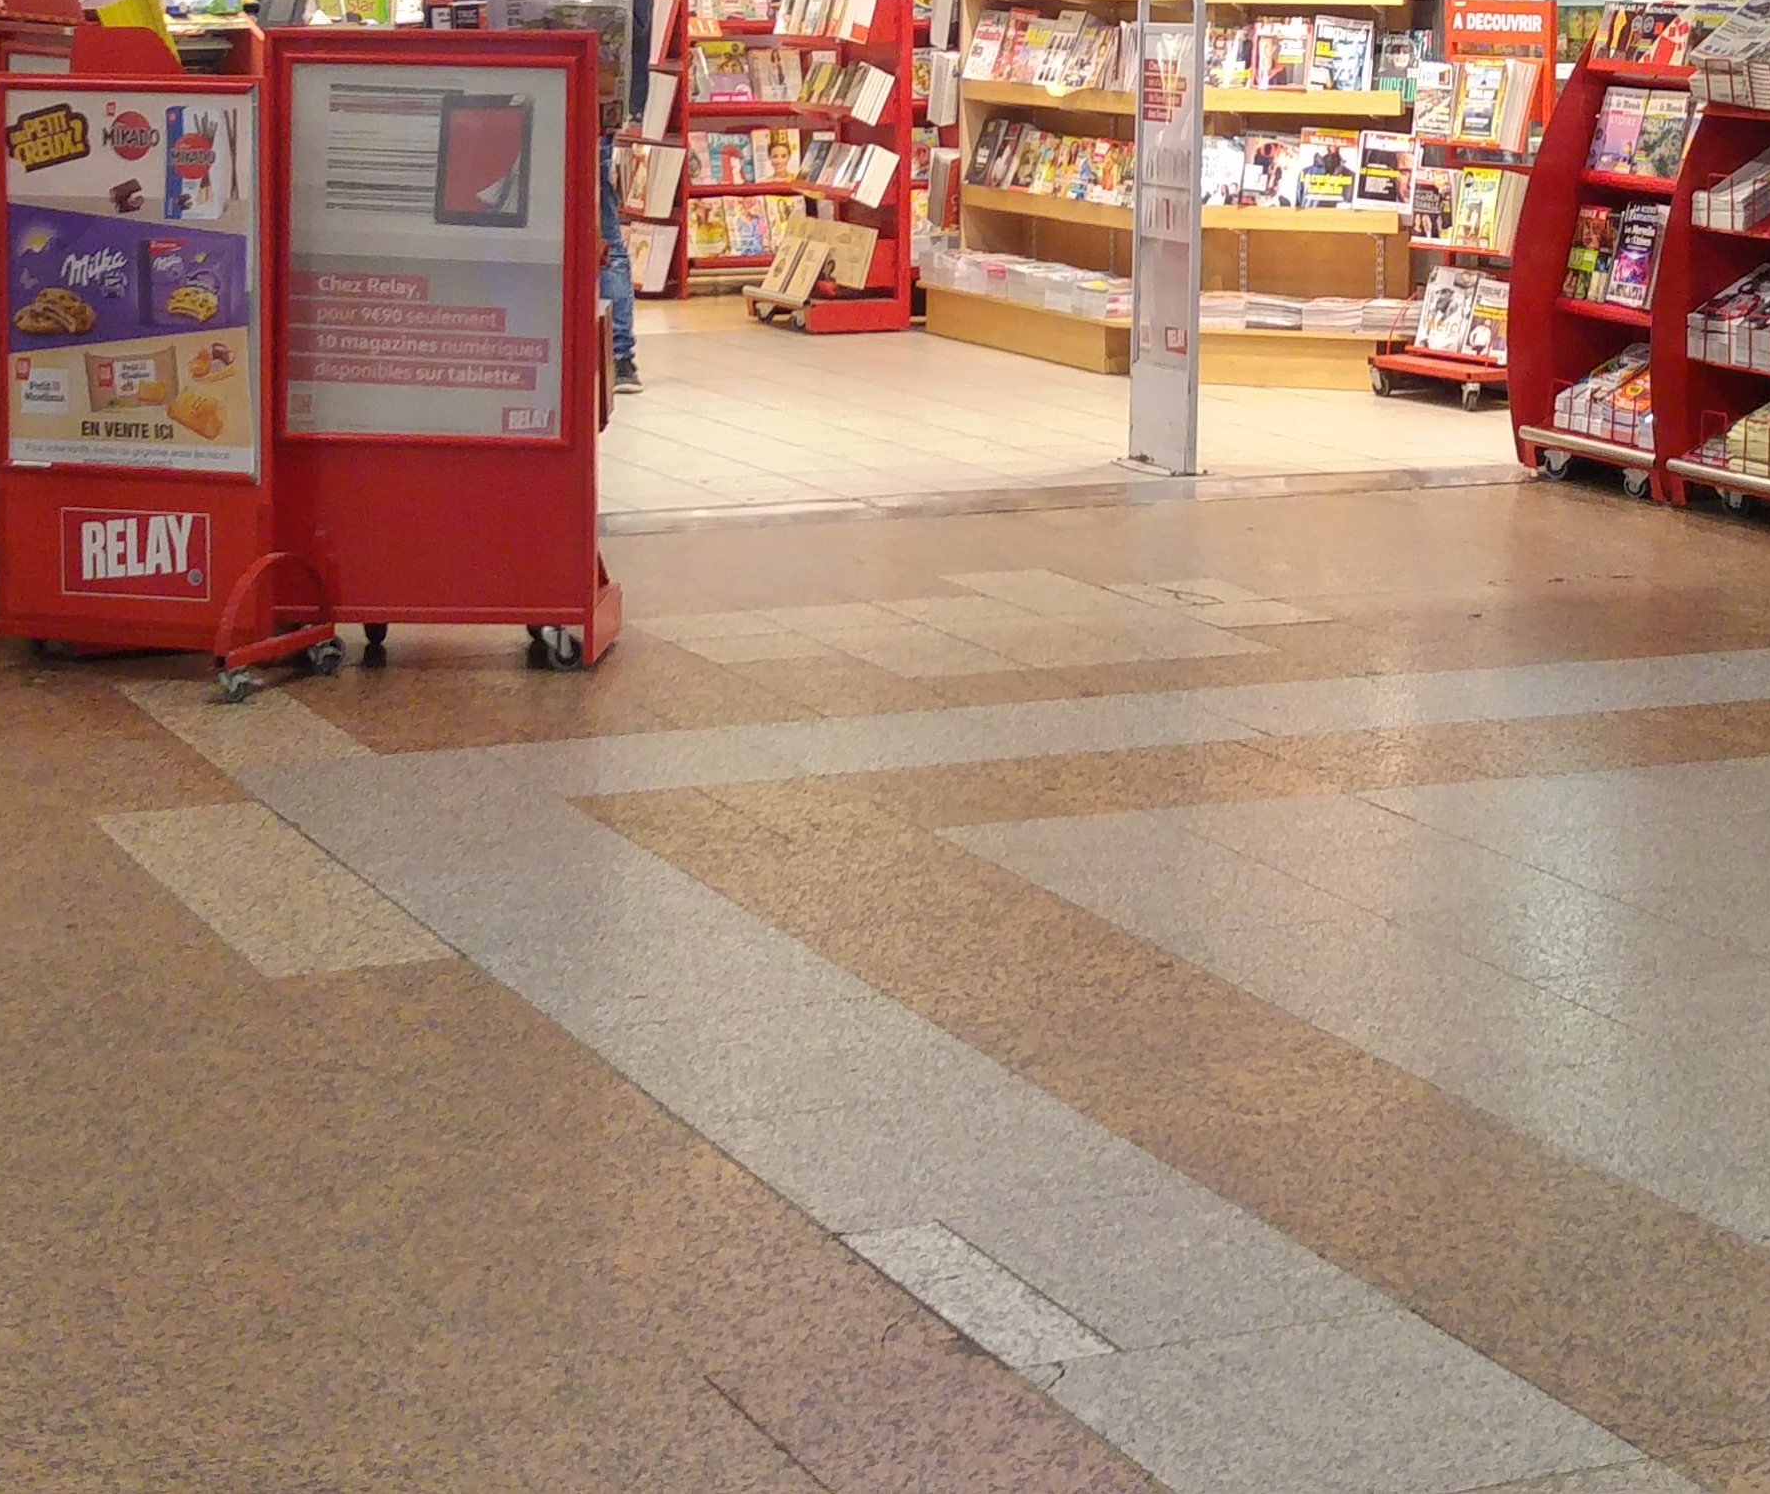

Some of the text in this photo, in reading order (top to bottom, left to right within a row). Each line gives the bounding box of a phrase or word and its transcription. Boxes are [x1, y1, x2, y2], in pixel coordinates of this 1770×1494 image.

[1453, 12, 1542, 32] A DECOUVRIR
[23, 110, 68, 139] PETIT
[102, 127, 161, 148] MIKADO
[171, 149, 216, 166] MIKADO
[61, 247, 128, 287] Milka
[318, 275, 421, 298] Chez Relay,
[316, 307, 357, 324] pour
[407, 308, 497, 327] seulement
[316, 333, 543, 360] 10 magazines numériques
[314, 361, 523, 384] disponibles sur tablette.
[81, 420, 174, 440] EN VENTE ICI
